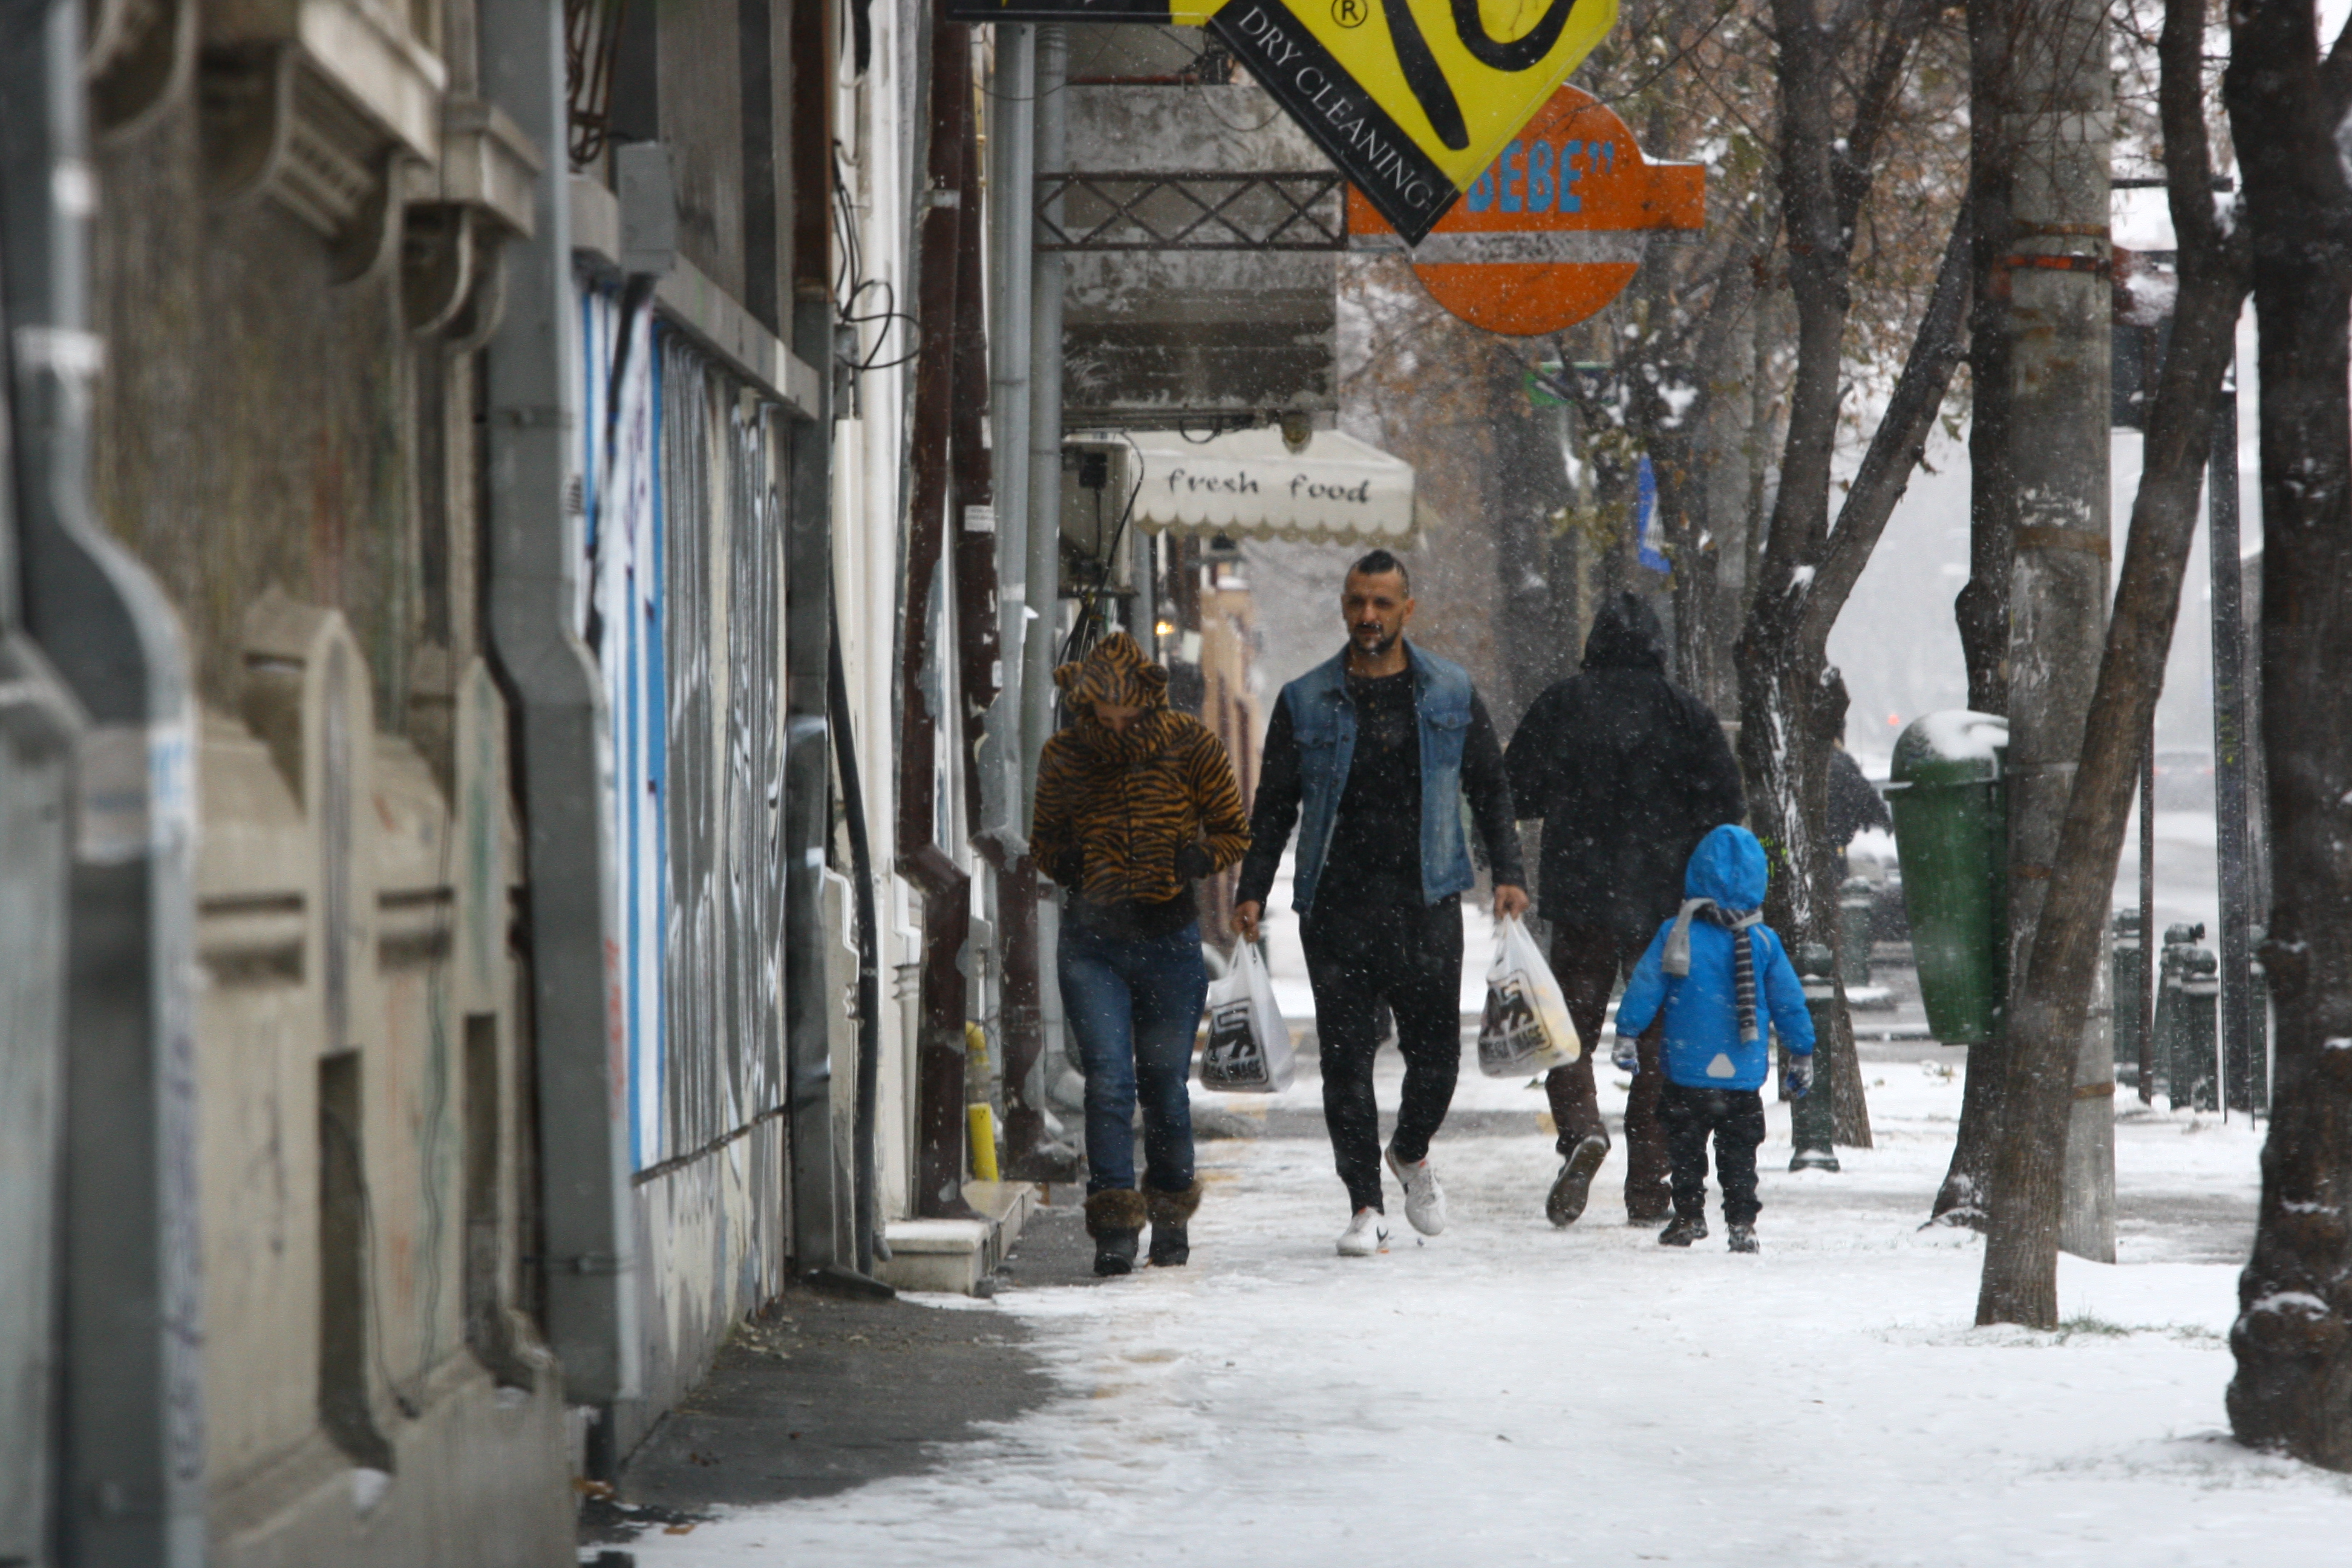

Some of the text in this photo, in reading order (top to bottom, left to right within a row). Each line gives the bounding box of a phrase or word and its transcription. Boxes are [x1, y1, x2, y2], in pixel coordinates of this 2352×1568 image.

[1238, 7, 1434, 209] DRY CLEANING
[1167, 468, 1370, 503] fresh food
